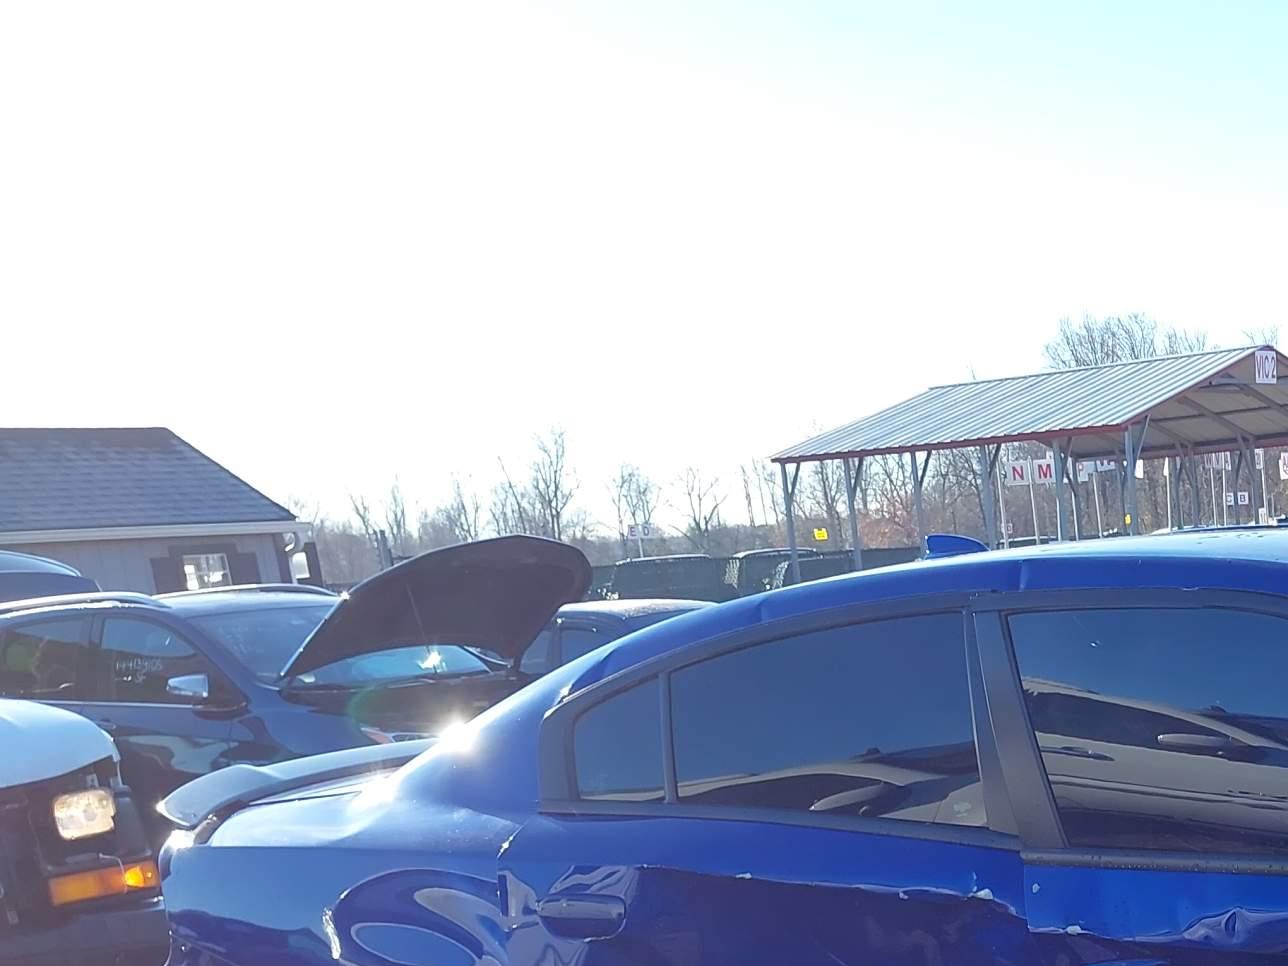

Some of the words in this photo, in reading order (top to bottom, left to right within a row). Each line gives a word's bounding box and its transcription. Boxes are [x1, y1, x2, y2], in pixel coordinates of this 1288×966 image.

[1012, 465, 1024, 480] N
[1038, 464, 1052, 479] M
[630, 526, 637, 536] E
